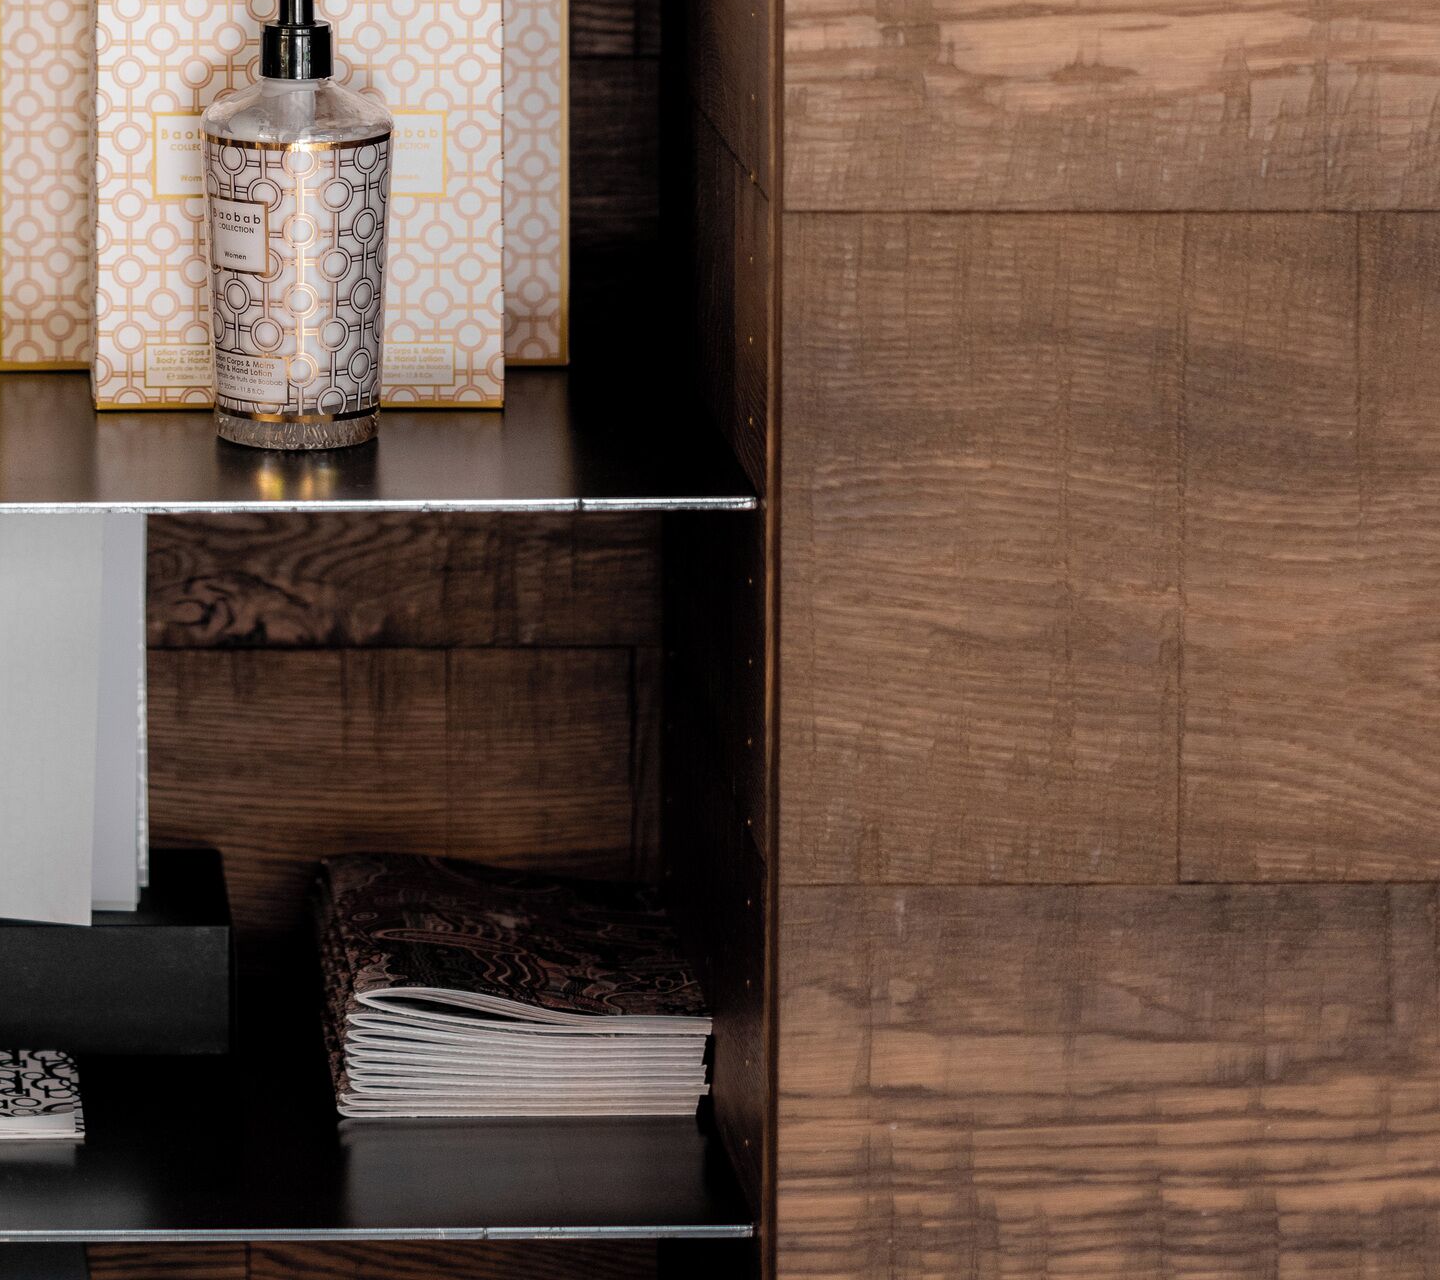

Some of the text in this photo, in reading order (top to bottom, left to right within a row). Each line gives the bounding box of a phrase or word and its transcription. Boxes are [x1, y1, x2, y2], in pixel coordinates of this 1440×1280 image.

[213, 207, 261, 225] Baobab
[224, 251, 247, 261] Women
[227, 357, 244, 367] Corps
[253, 361, 275, 369] Mains
[232, 366, 248, 375] Hand
[251, 369, 273, 377] Lotion
